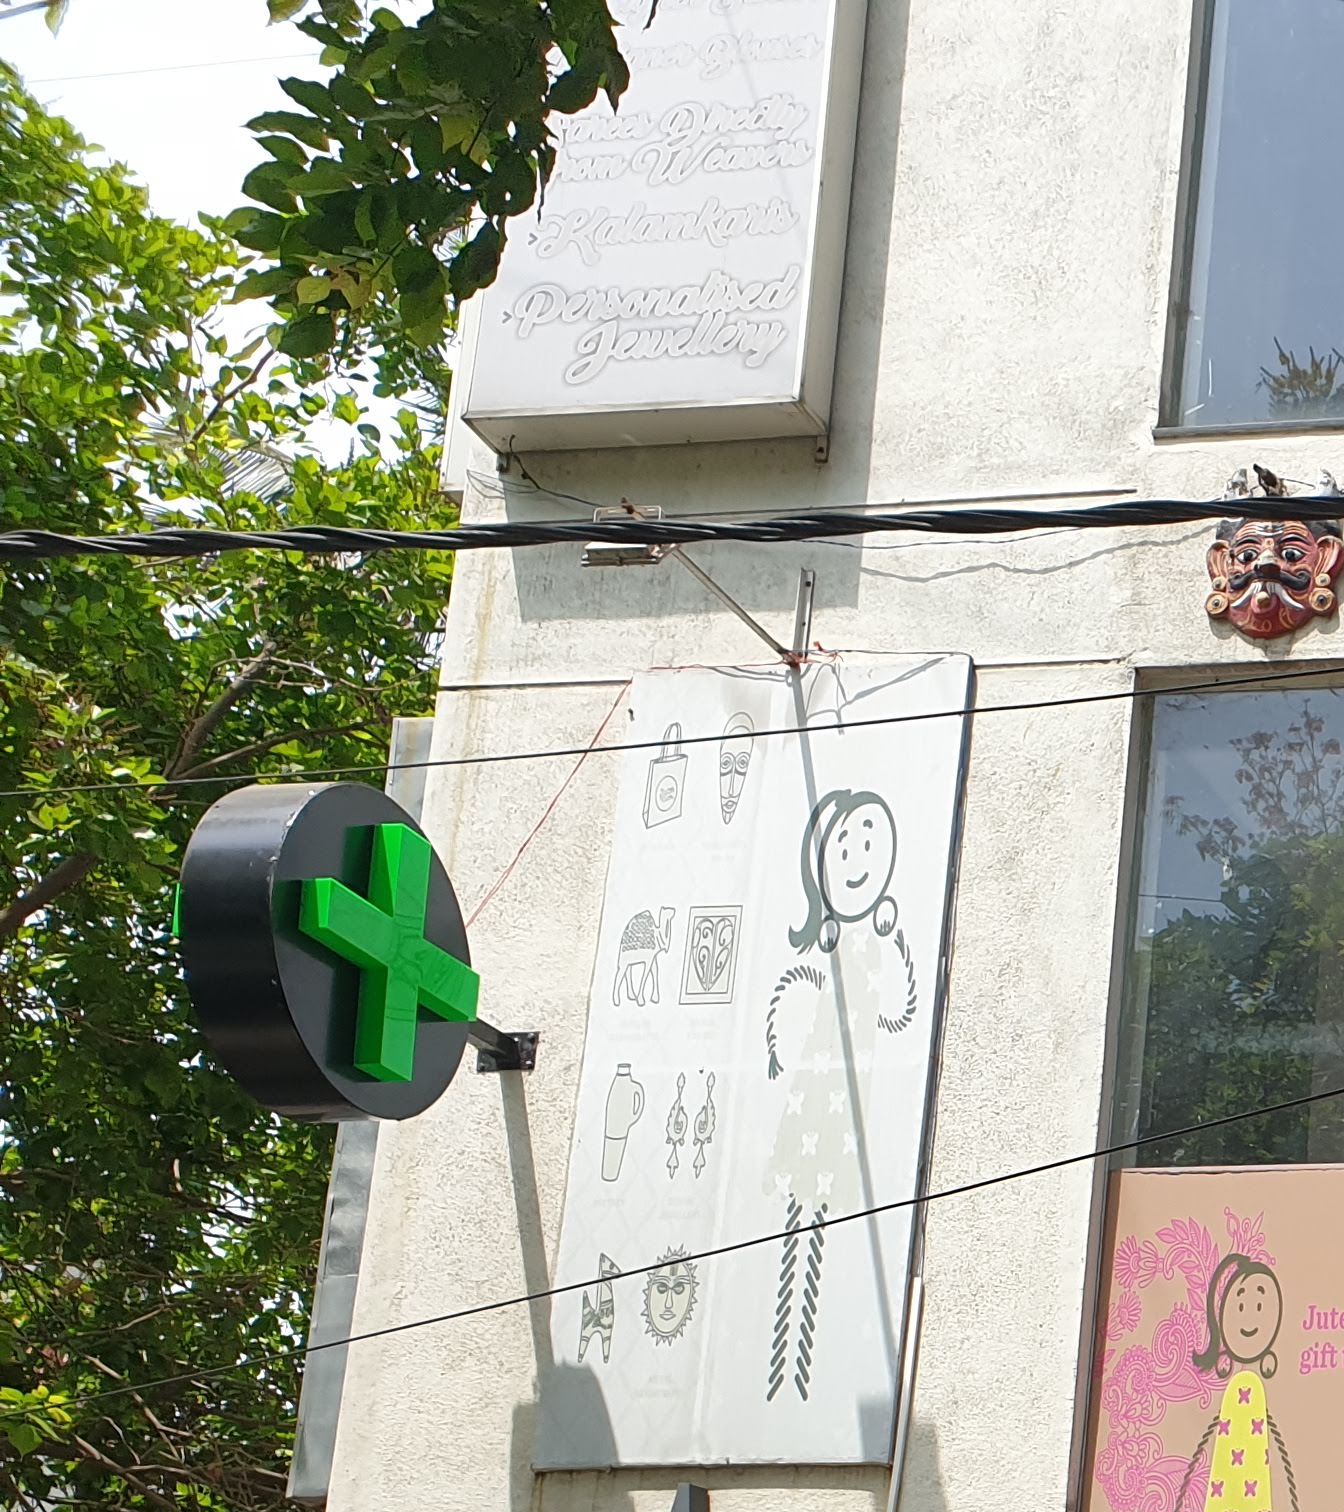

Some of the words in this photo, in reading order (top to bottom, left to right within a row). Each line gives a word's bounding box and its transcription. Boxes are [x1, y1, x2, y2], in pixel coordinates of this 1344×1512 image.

[515, 265, 802, 339] Personalised
[563, 312, 788, 386] Jewellery
[1299, 1344, 1341, 1376] gift
